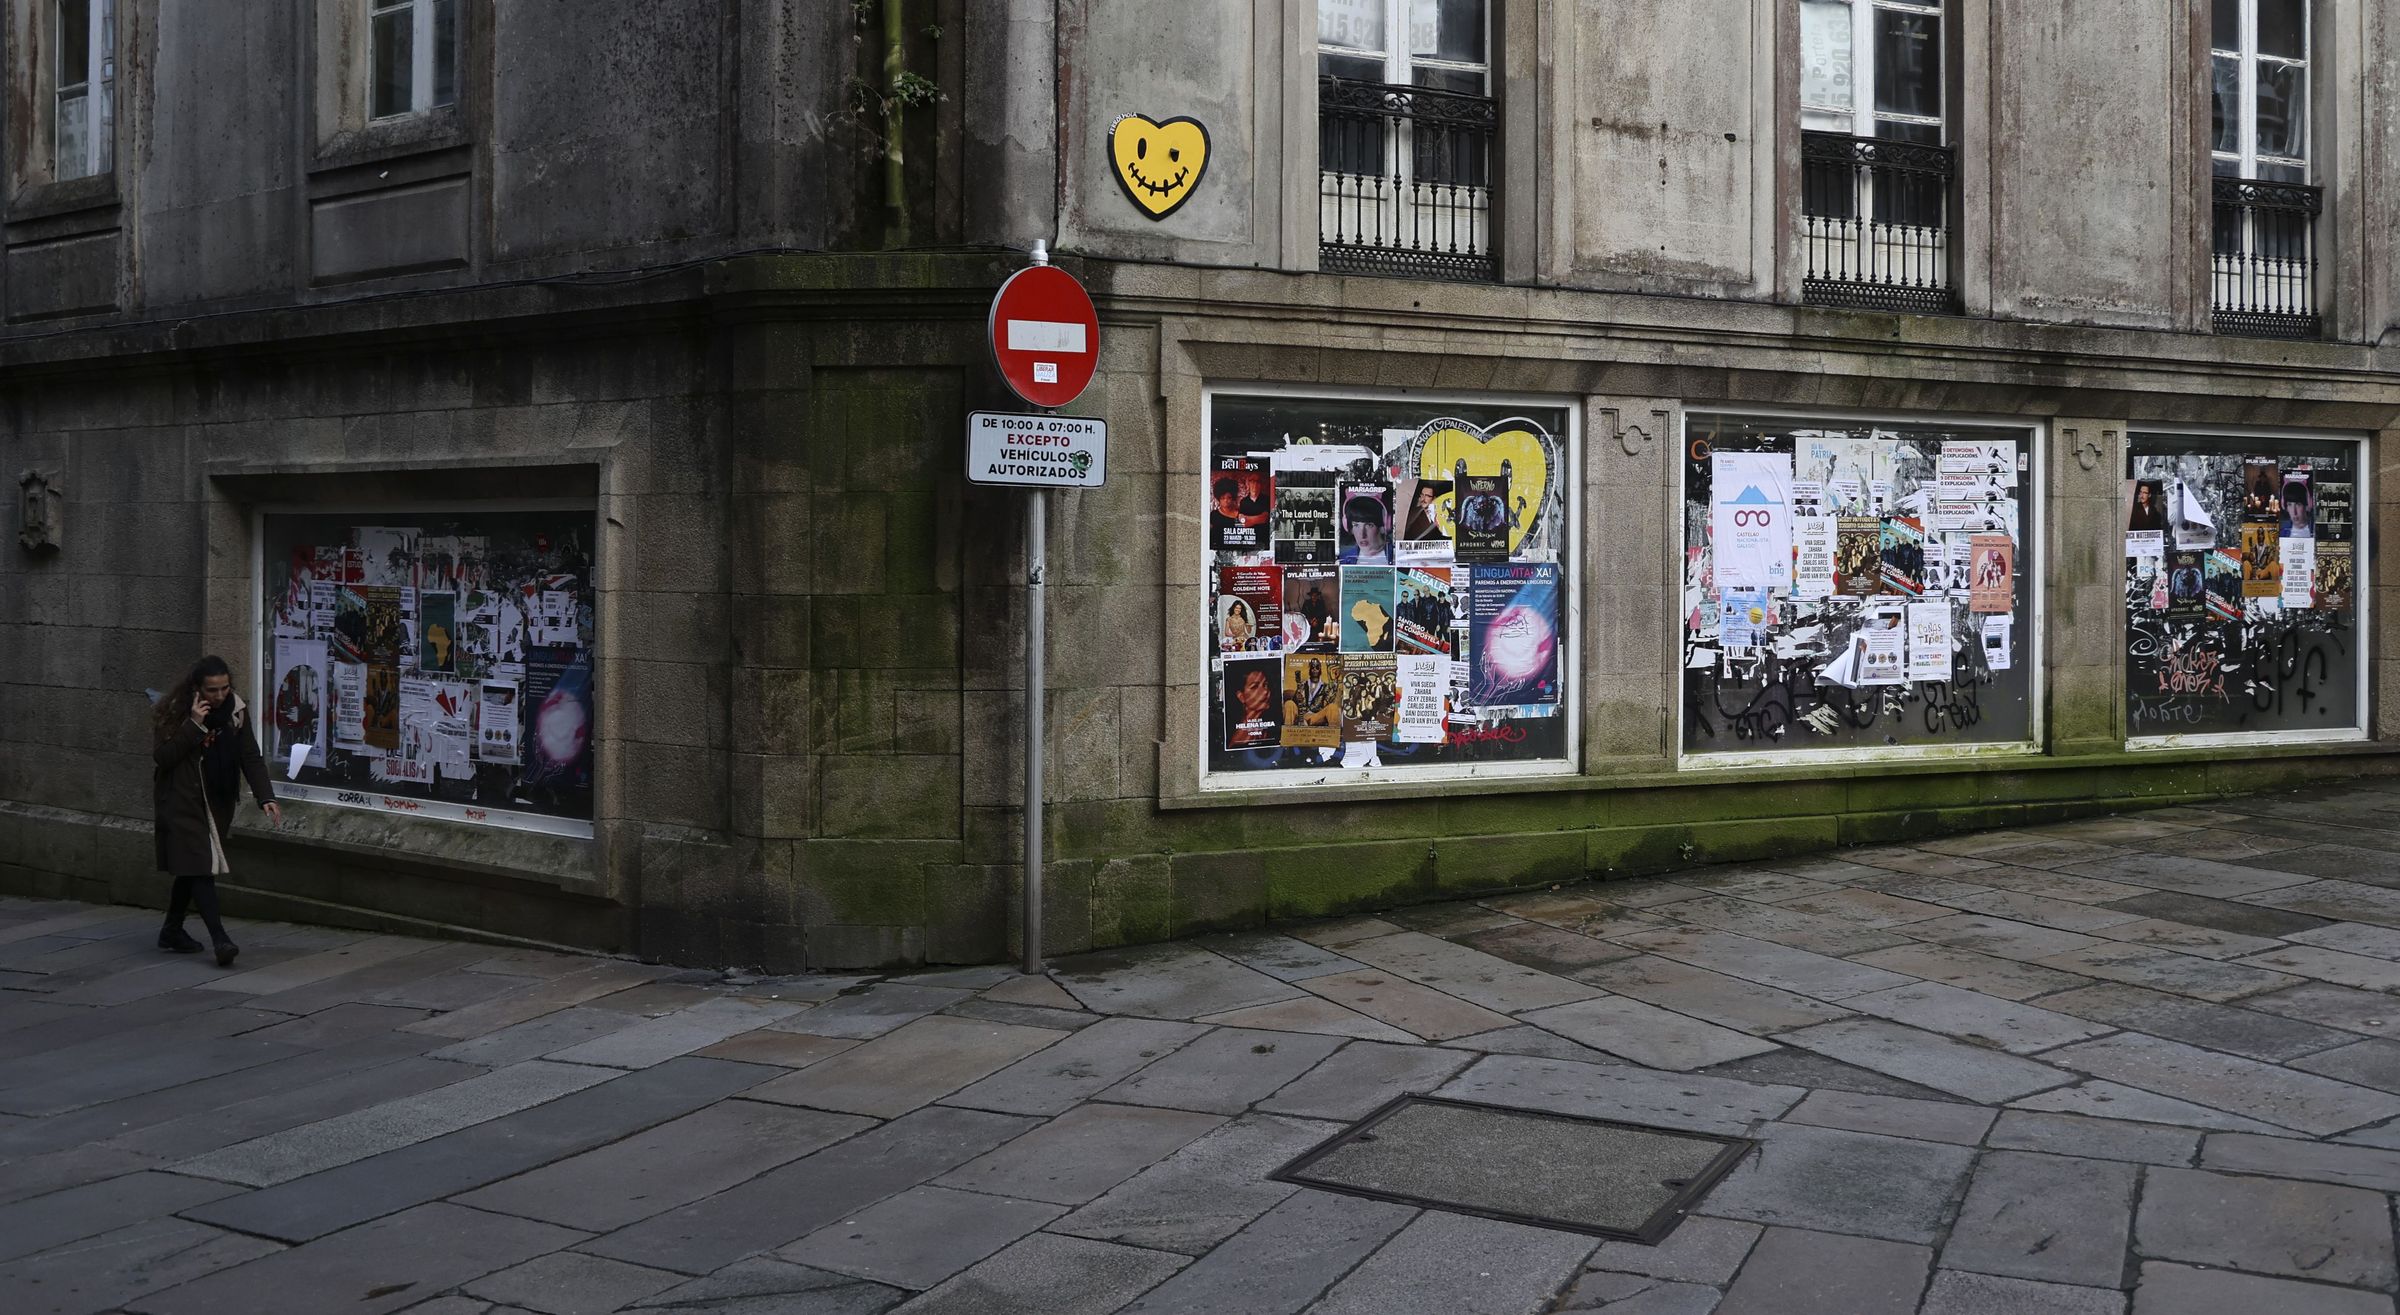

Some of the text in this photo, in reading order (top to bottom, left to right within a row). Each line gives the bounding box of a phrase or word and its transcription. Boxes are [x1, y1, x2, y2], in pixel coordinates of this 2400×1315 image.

[982, 418, 1096, 434] DE 10:00 A 07:00 H.
[1007, 434, 1070, 447] EXCEPTO
[1000, 448, 1075, 463] VEHÍCULOS
[988, 463, 1087, 479] AUTORIZADOS
[1282, 509, 1329, 518] The Loved Ones
[1399, 541, 1450, 550] NICK WATERHOUSE
[1536, 567, 1552, 578] XA!
[1769, 566, 1785, 576] bng
[1408, 567, 1450, 593] ILEGALES
